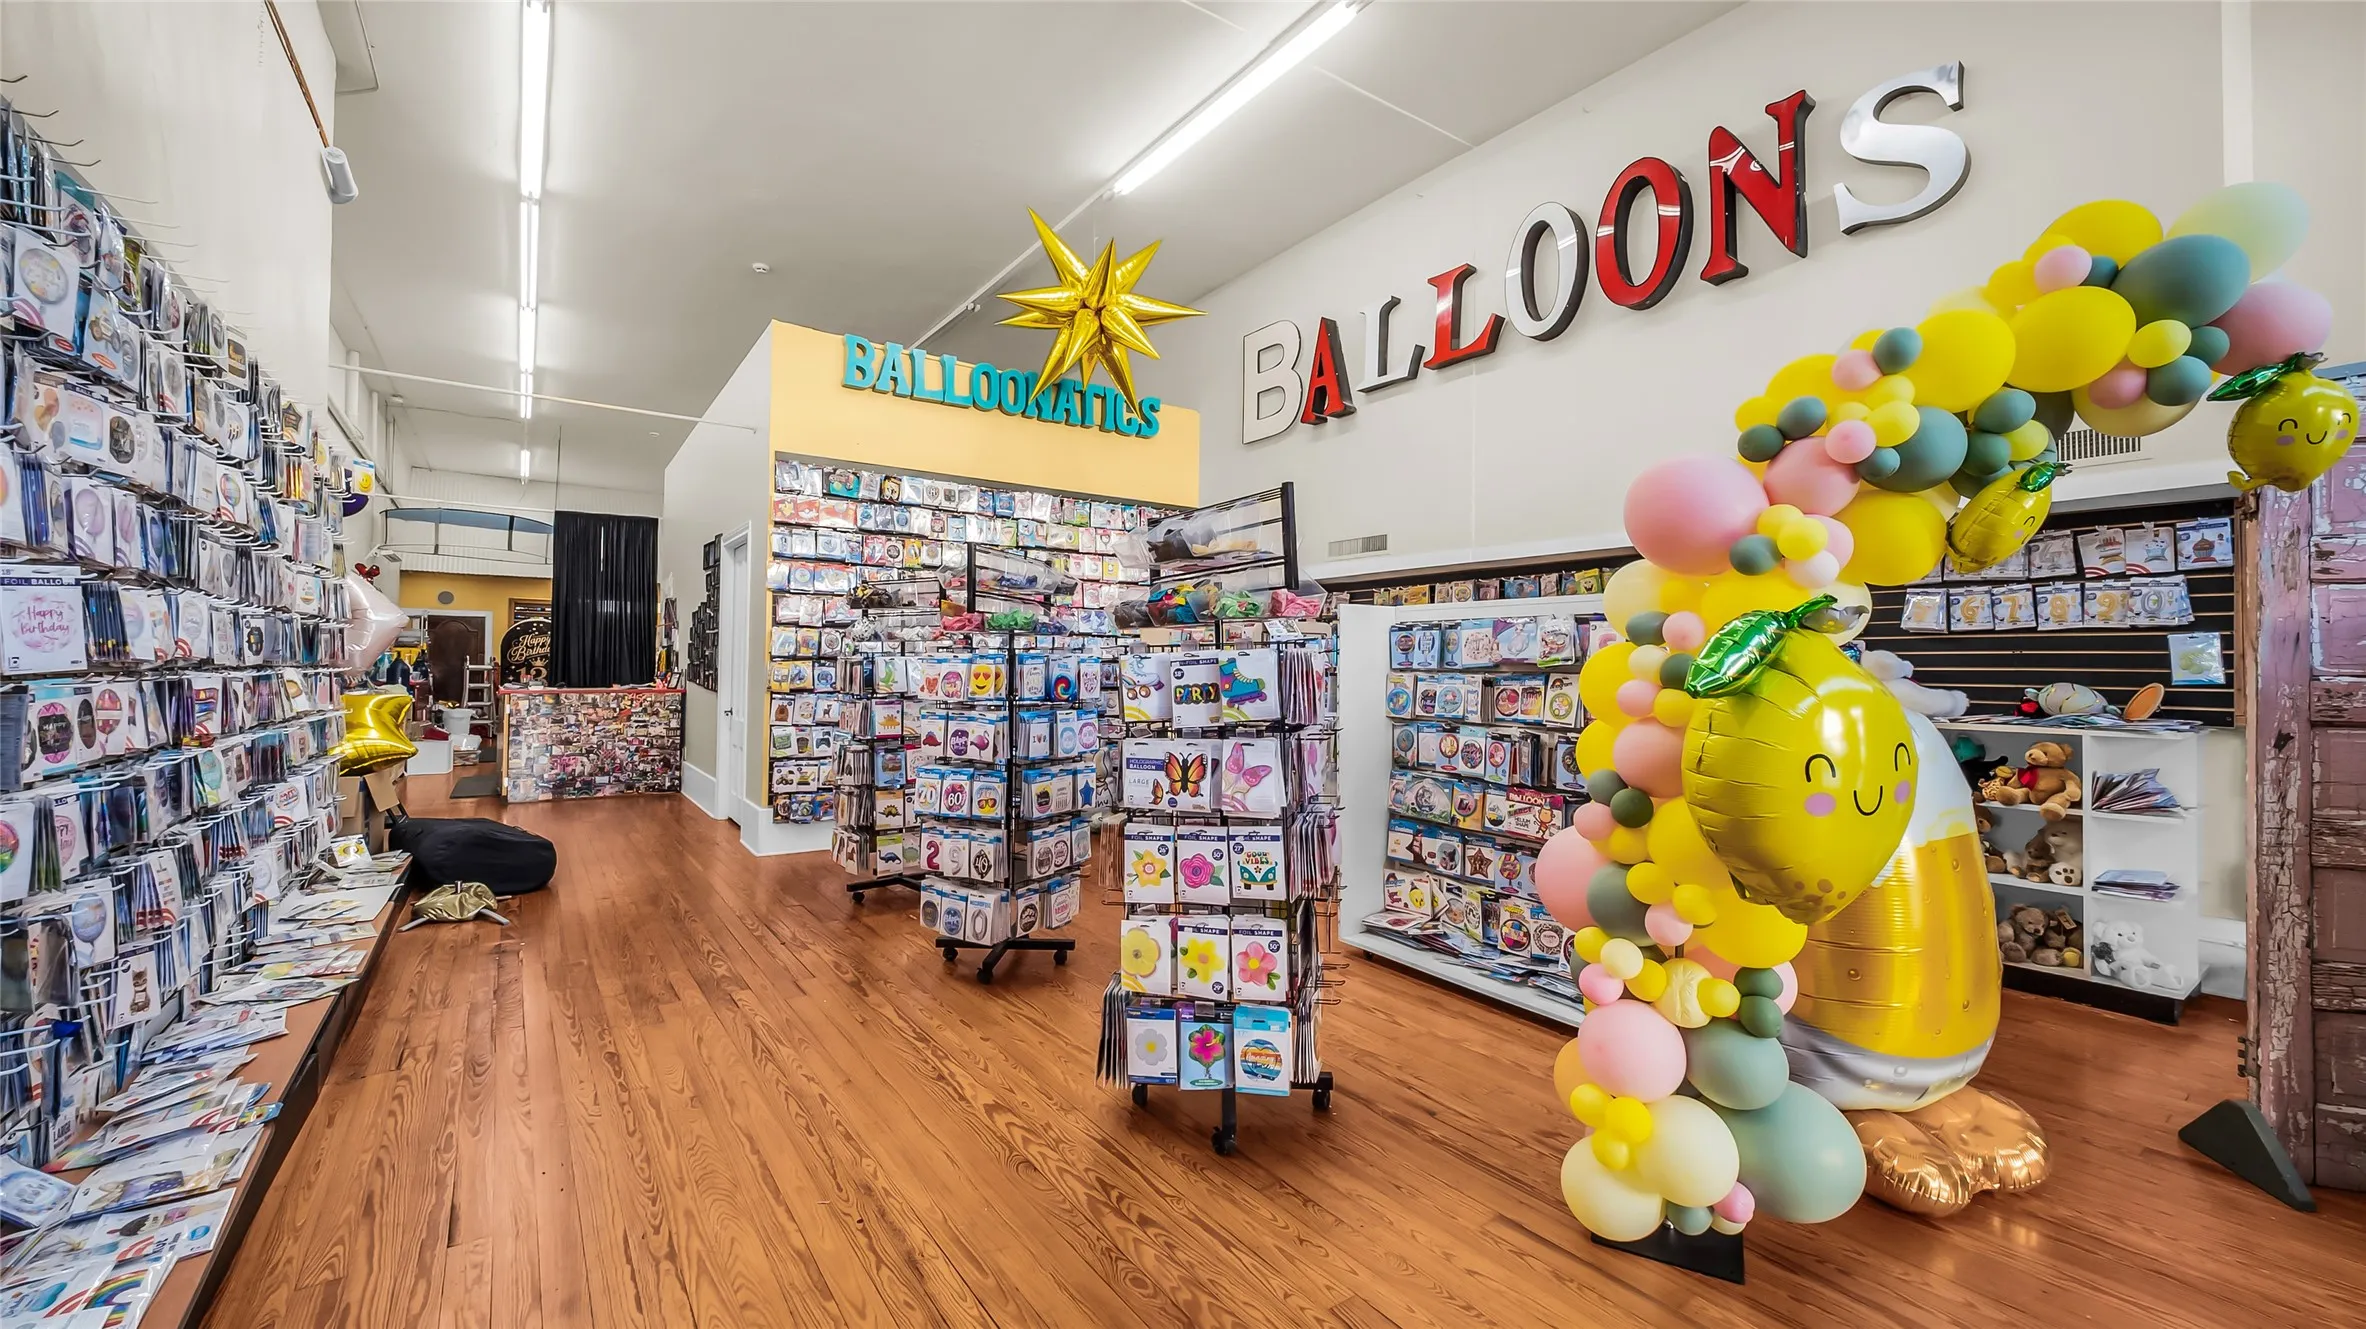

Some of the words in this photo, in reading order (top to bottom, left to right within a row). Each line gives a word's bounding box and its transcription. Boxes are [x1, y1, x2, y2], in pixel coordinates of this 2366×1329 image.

[1242, 60, 1971, 444] BALLOONS
[842, 333, 1161, 439] BALLOONATICS
[27, 605, 63, 621] Happy
[20, 620, 70, 635] Birthday
[519, 633, 551, 648] Happy
[1175, 684, 1218, 703] PARTY
[948, 792, 962, 807] 60
[1245, 857, 1270, 865] VIBES
[1200, 927, 1220, 935] SHAPE
